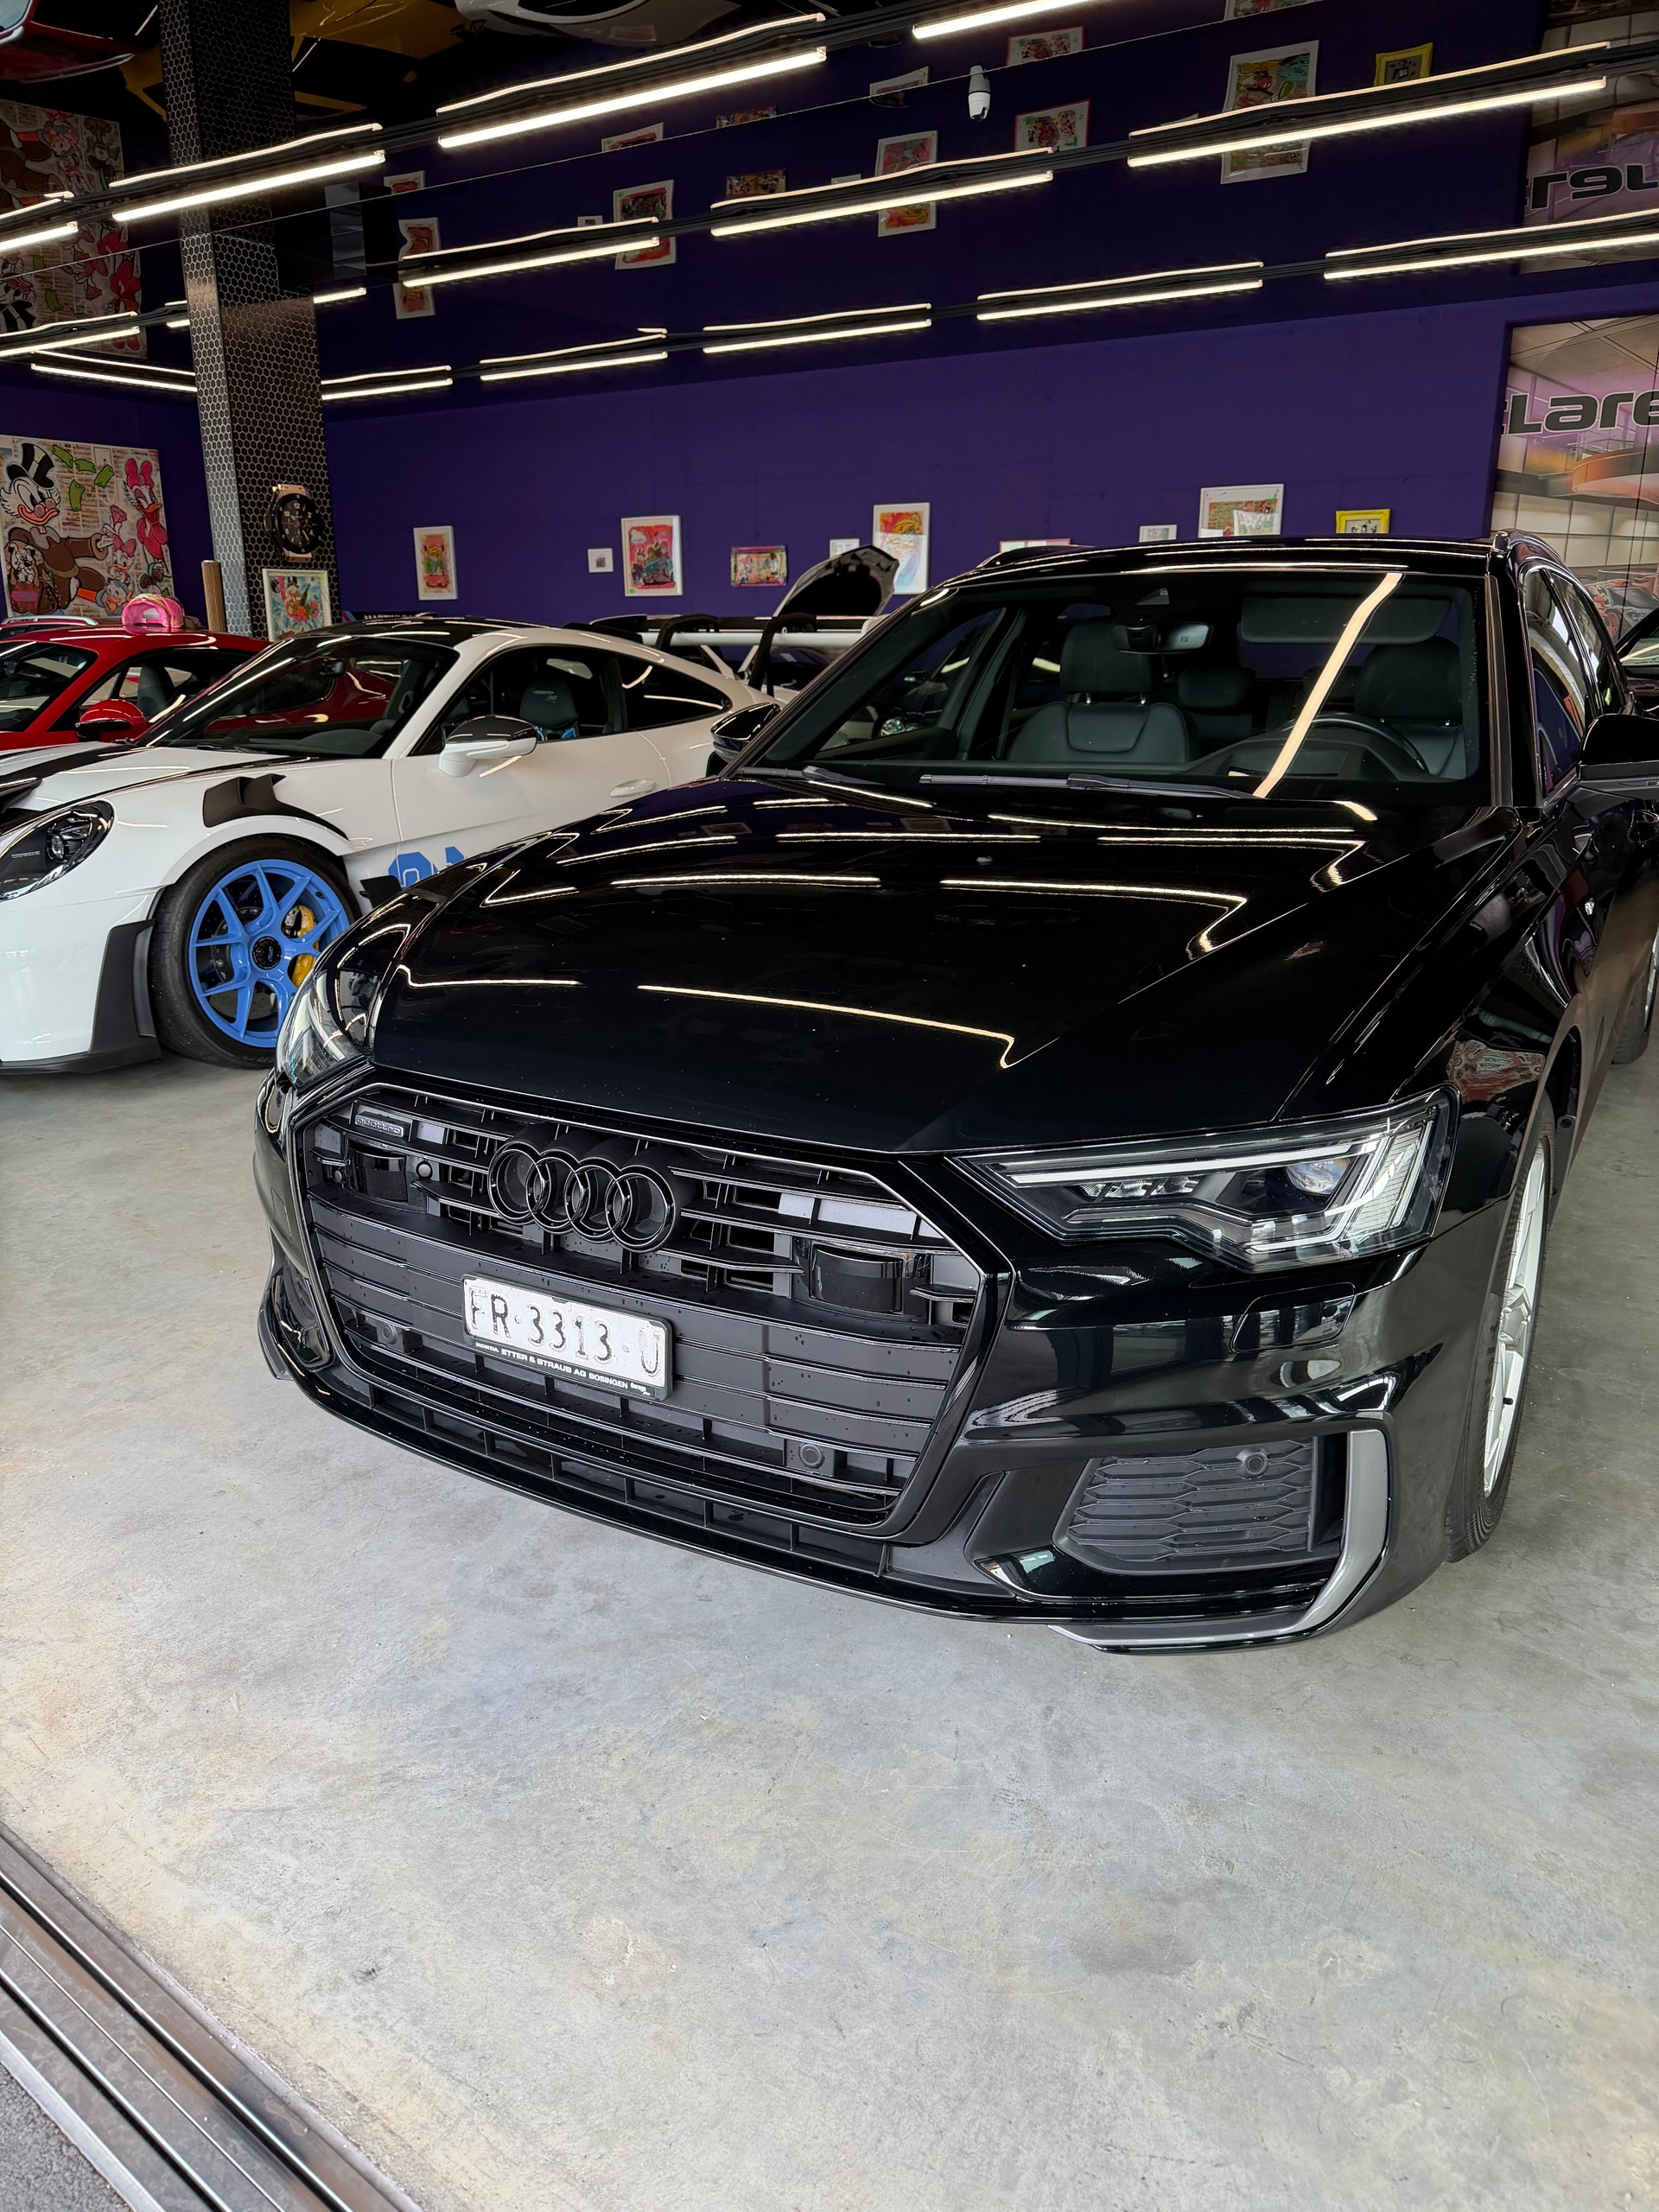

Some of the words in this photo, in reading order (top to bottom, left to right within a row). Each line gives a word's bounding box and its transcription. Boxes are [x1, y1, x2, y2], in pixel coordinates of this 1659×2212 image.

[469, 1287, 512, 1338] FR
[526, 1301, 615, 1363] 3313
[639, 1325, 662, 1377] U
[501, 1348, 528, 1362] ETTER
[537, 1357, 572, 1374] STRAUB
[573, 1369, 587, 1377] AG
